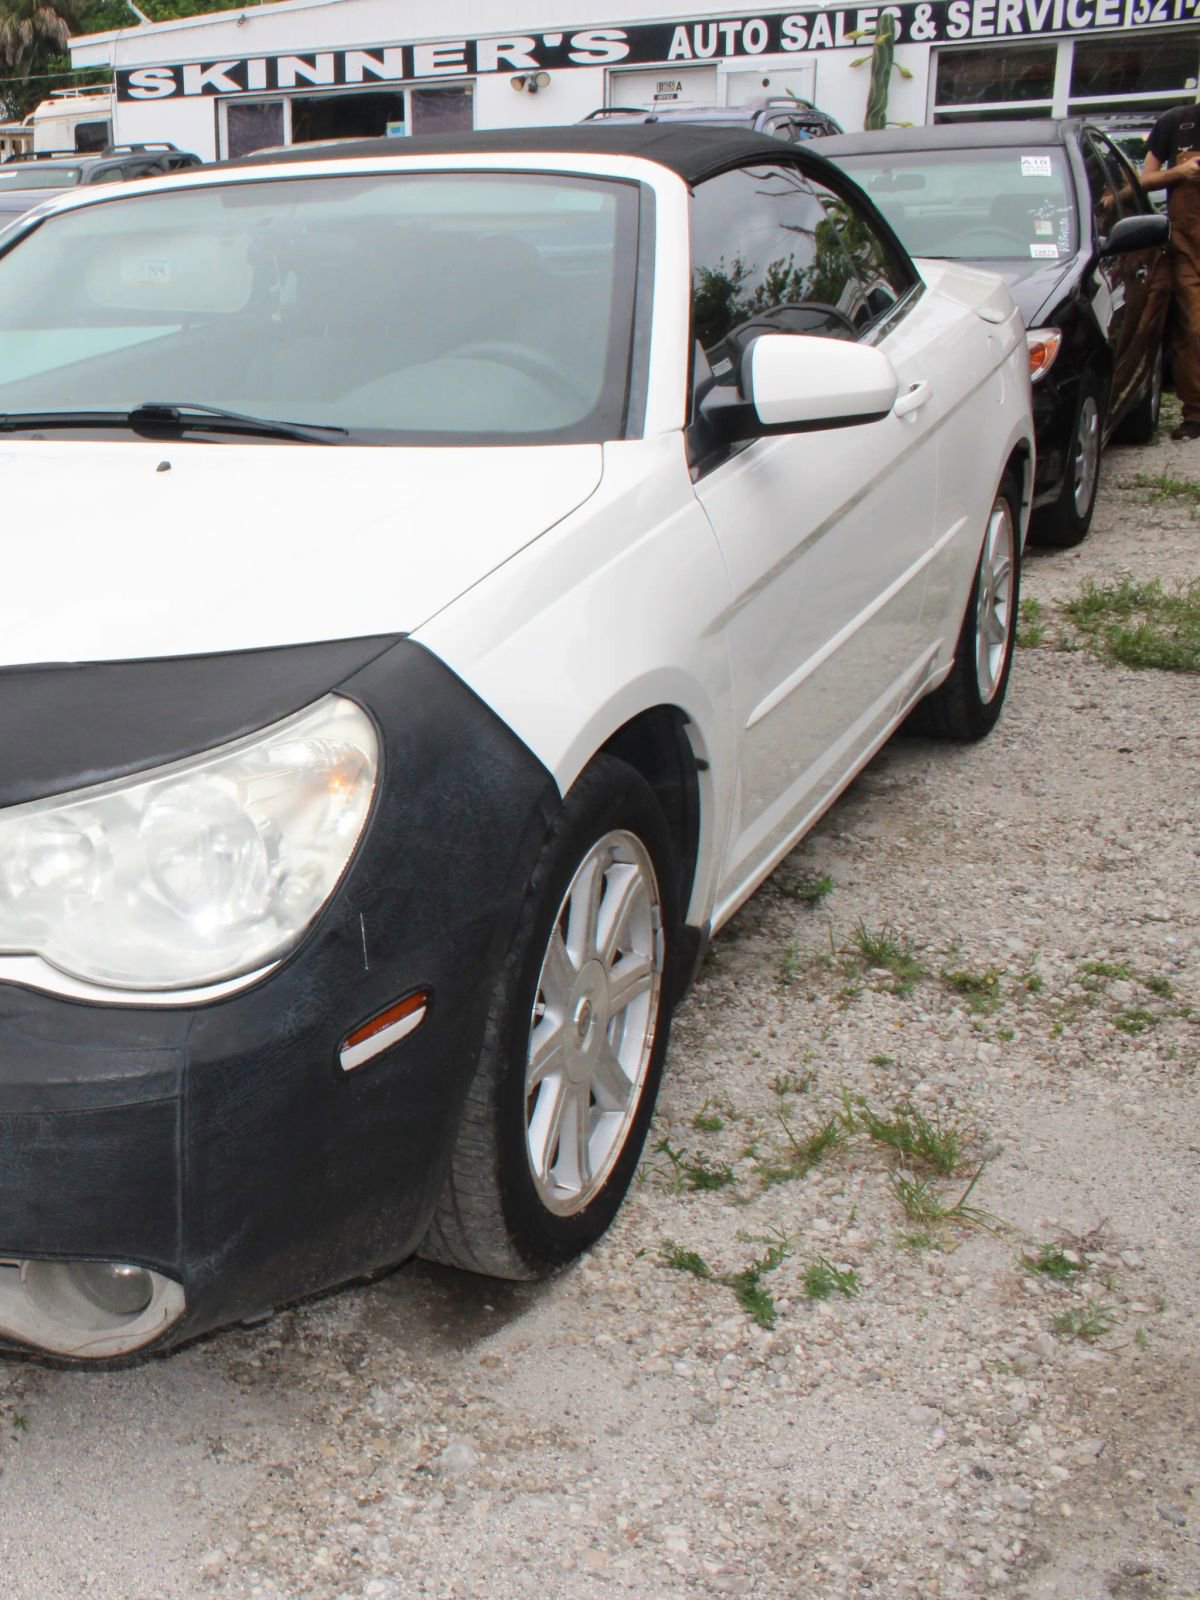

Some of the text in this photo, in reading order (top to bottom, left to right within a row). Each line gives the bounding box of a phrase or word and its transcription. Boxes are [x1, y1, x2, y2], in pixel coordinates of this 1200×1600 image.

[127, 29, 630, 99] SKINNER'S
[668, 18, 768, 60] AUTO
[910, 3, 937, 40] &
[946, 0, 1120, 38] SERVICE
